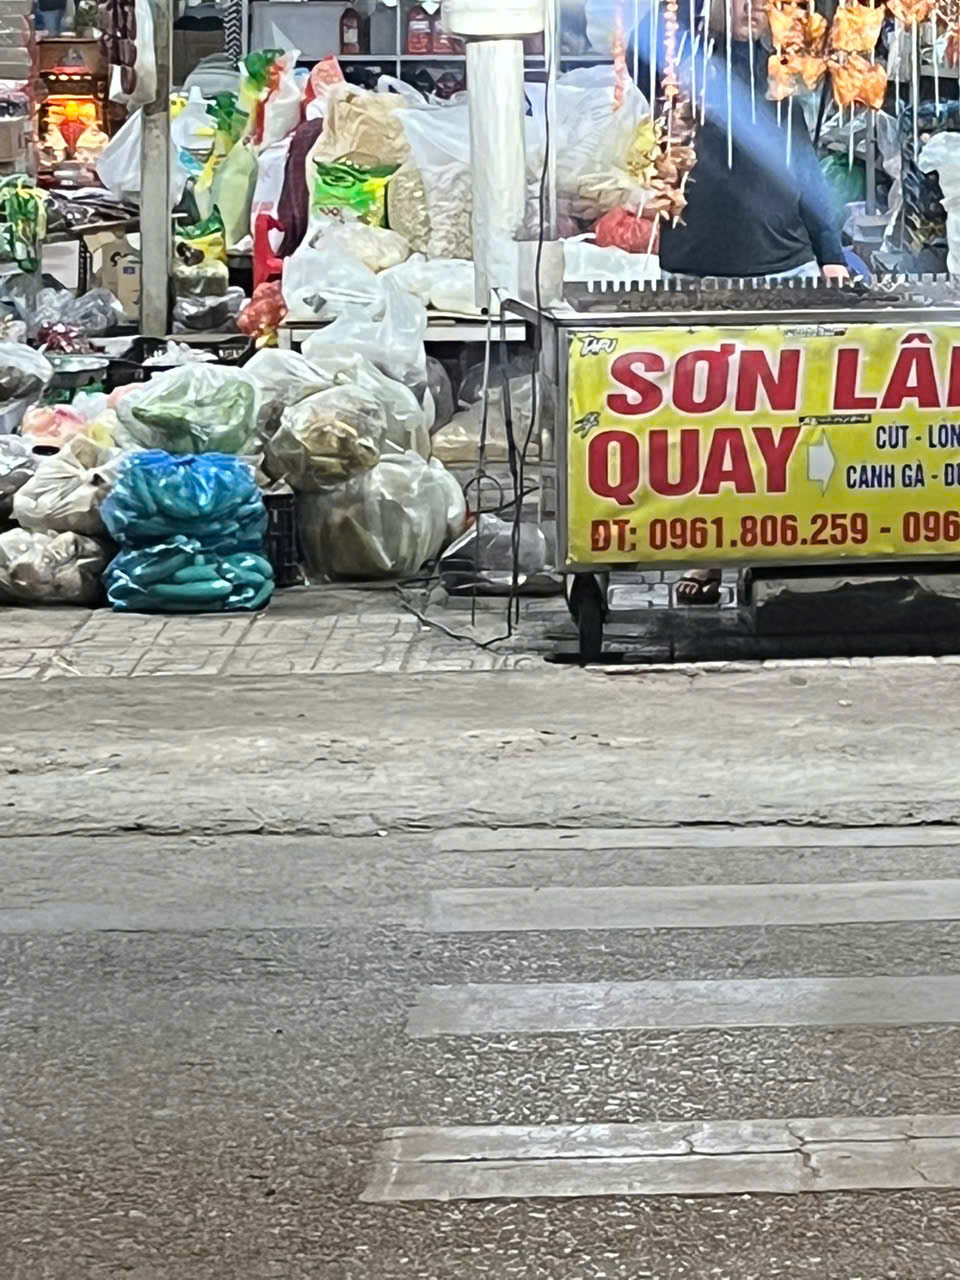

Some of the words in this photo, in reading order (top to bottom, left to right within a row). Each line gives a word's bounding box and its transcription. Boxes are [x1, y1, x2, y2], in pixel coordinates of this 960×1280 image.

[606, 343, 800, 416] SƠN
[588, 426, 801, 506] QUAY
[591, 519, 637, 552] ĐT:
[650, 513, 868, 550] 0961.806.259
